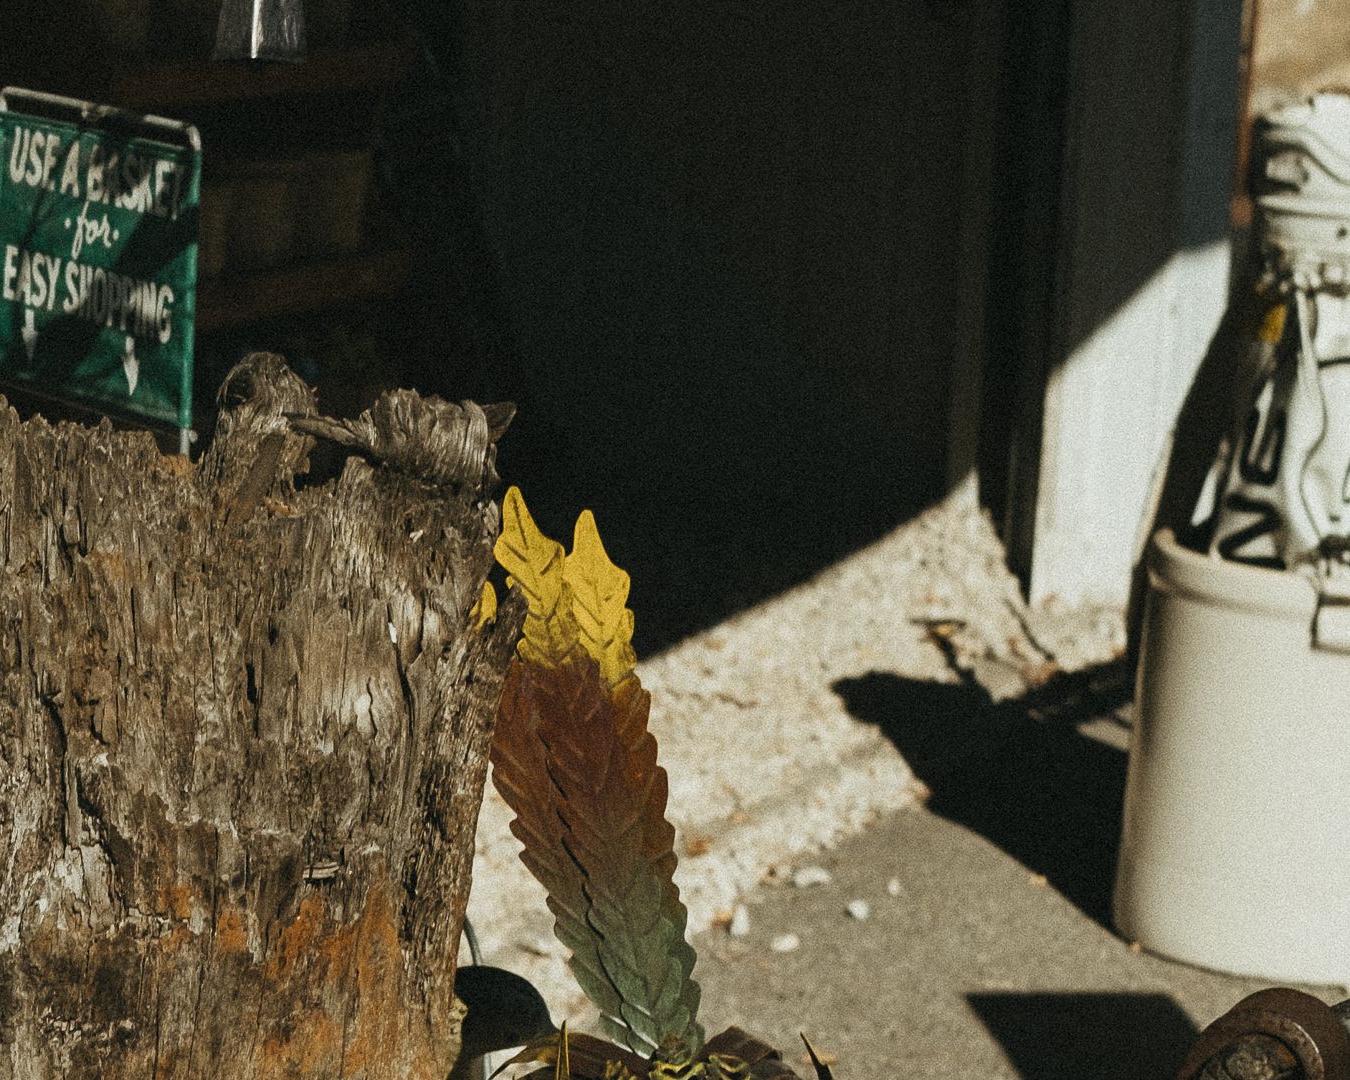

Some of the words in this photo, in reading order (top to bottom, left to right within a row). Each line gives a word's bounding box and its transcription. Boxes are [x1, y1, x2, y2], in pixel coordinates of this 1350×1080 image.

[9, 125, 61, 192] USE
[60, 140, 81, 198] A
[86, 144, 186, 221] BASKET
[3, 244, 62, 312] EASY
[63, 260, 175, 344] SHOPPING
